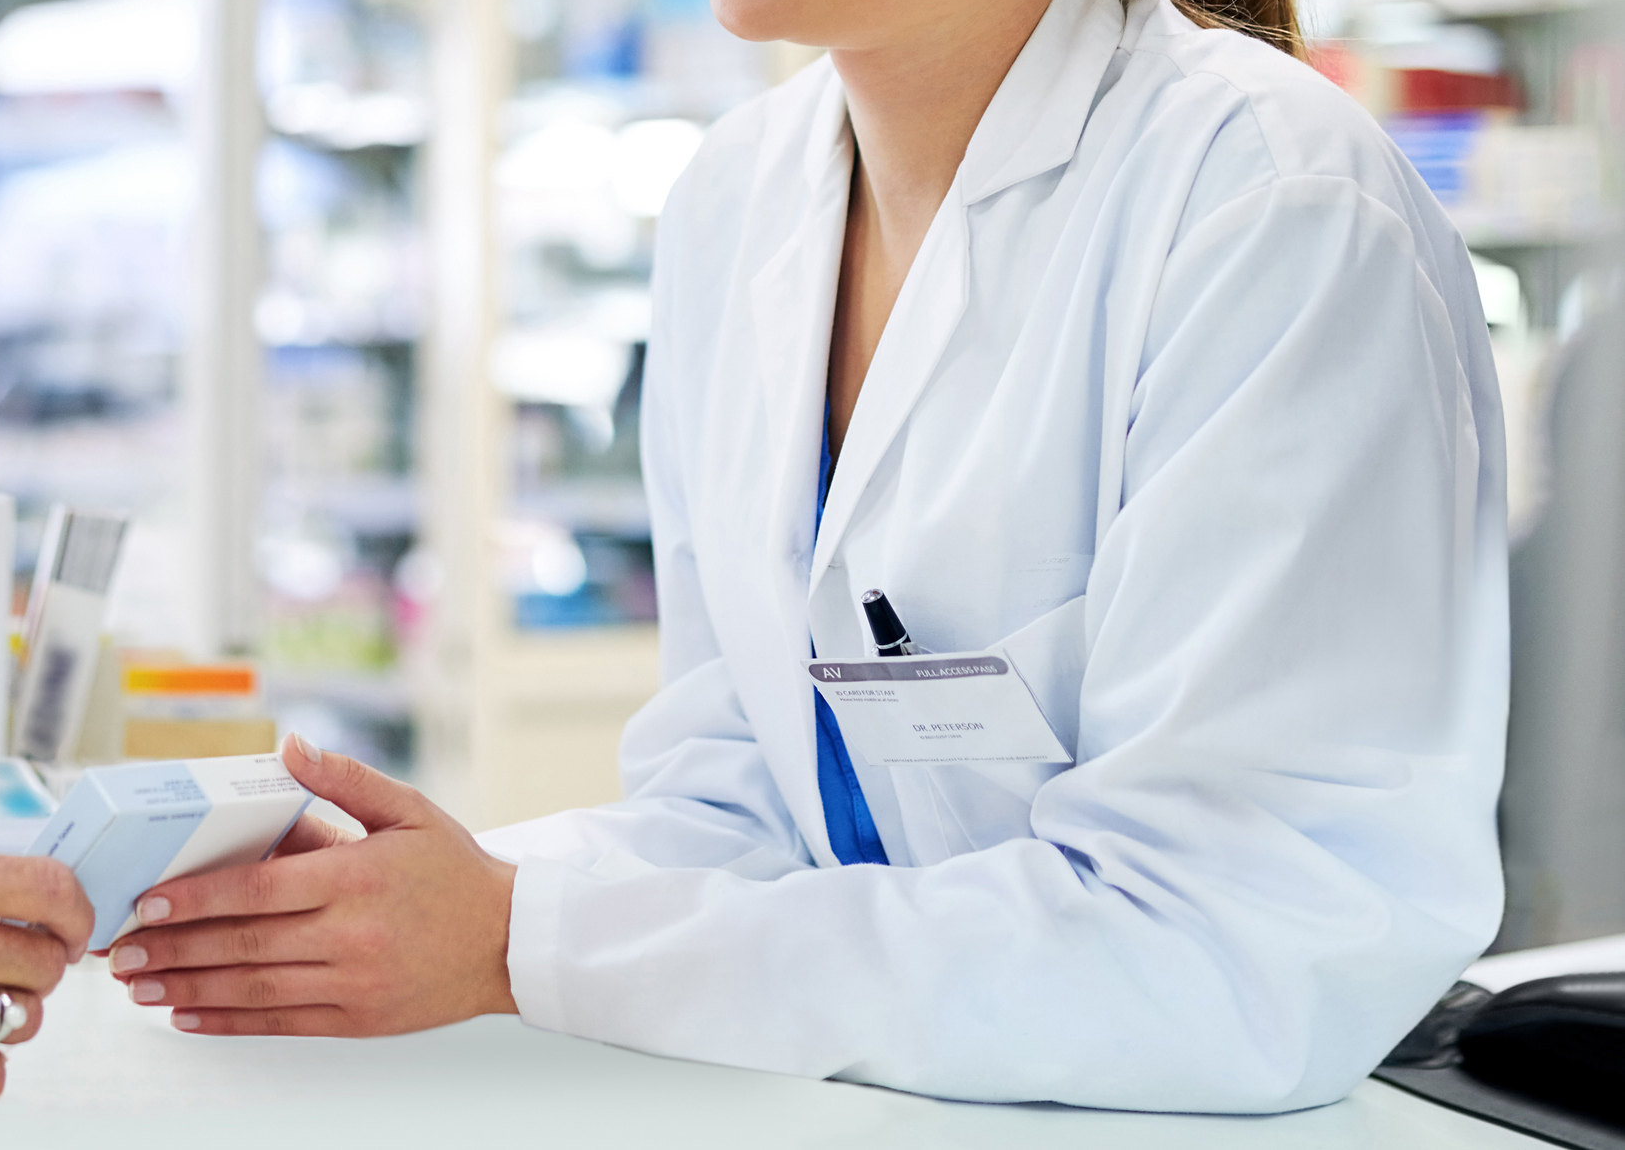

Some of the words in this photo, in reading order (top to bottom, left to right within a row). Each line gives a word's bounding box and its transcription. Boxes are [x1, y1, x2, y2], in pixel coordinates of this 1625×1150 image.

[823, 667, 842, 679] AV
[915, 669, 939, 678] FULL
[940, 666, 976, 677] ACCESS
[974, 665, 998, 674] PASS
[912, 724, 931, 732] DR.
[930, 722, 984, 731] PETERSON
